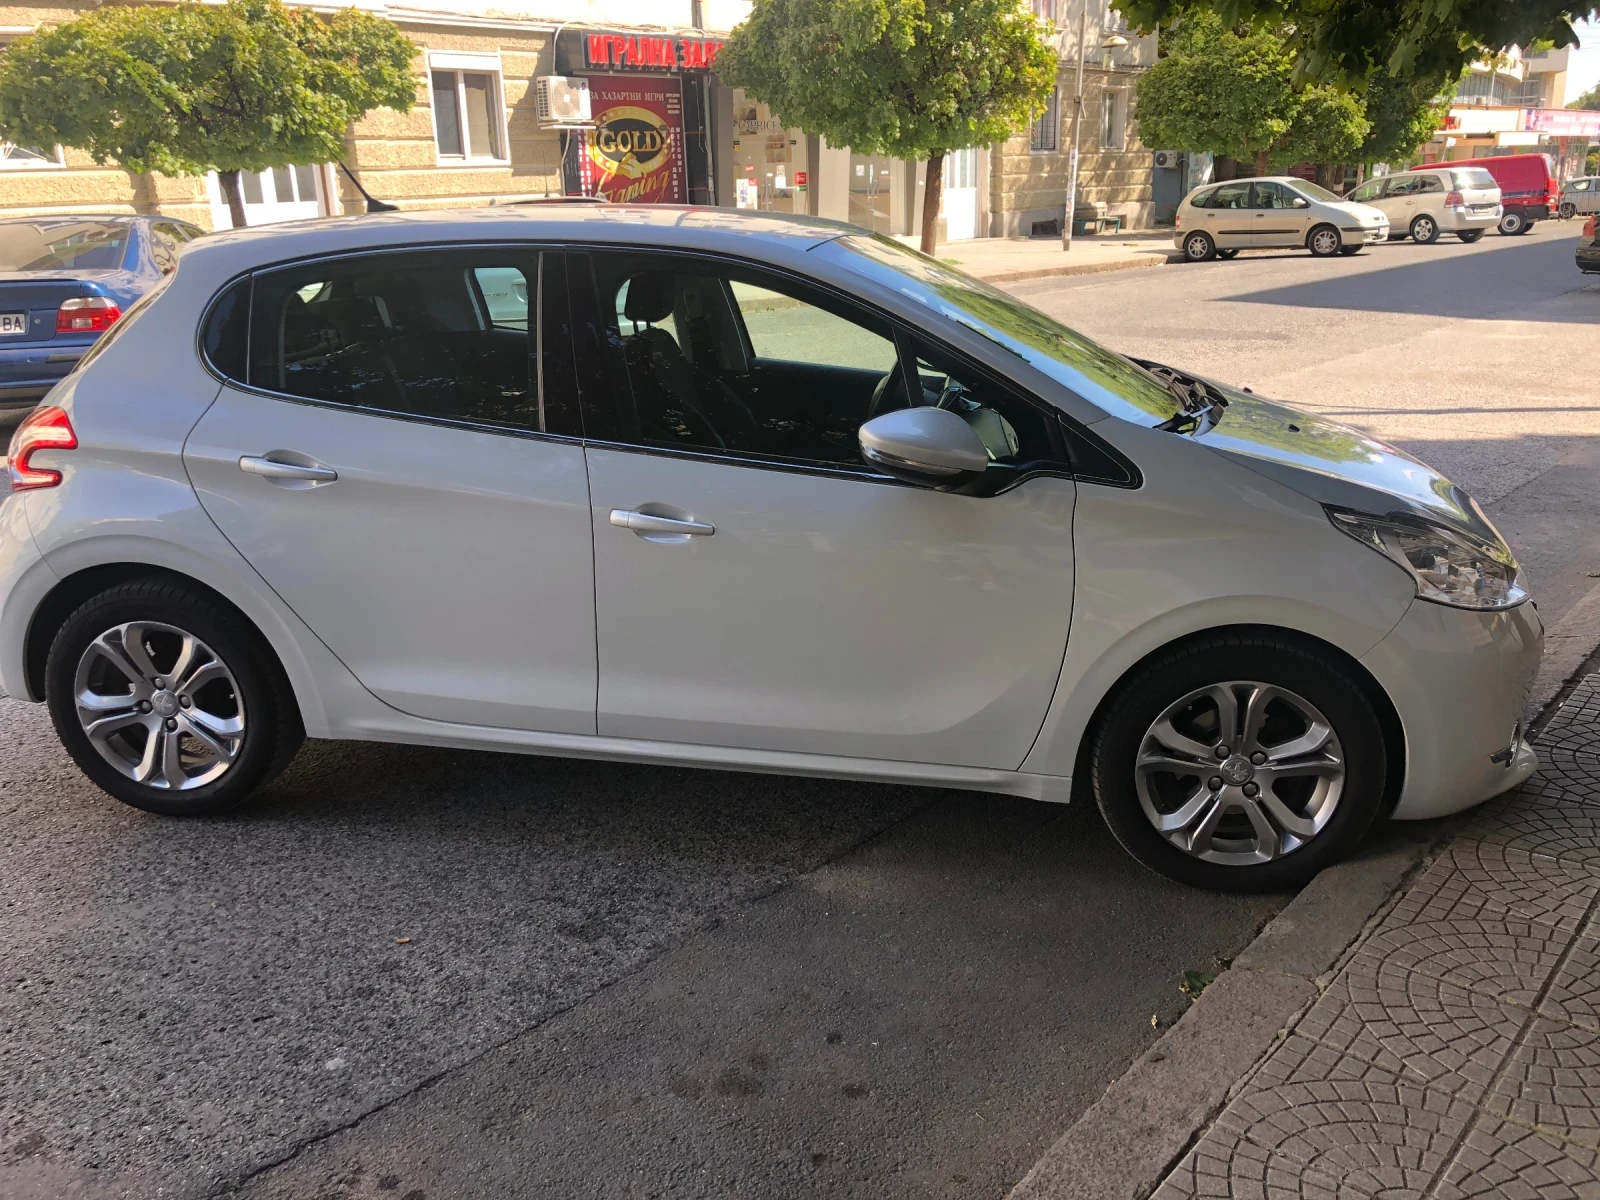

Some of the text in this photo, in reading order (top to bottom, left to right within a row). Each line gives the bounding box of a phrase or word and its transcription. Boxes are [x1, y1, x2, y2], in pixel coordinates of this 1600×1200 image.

[588, 34, 676, 67] ИГРАЛНА
[602, 91, 642, 101] ХАЗАРТНИ
[645, 93, 664, 101] ИГРИ
[738, 120, 778, 132] CAPRICE
[599, 129, 661, 152] GOLD
